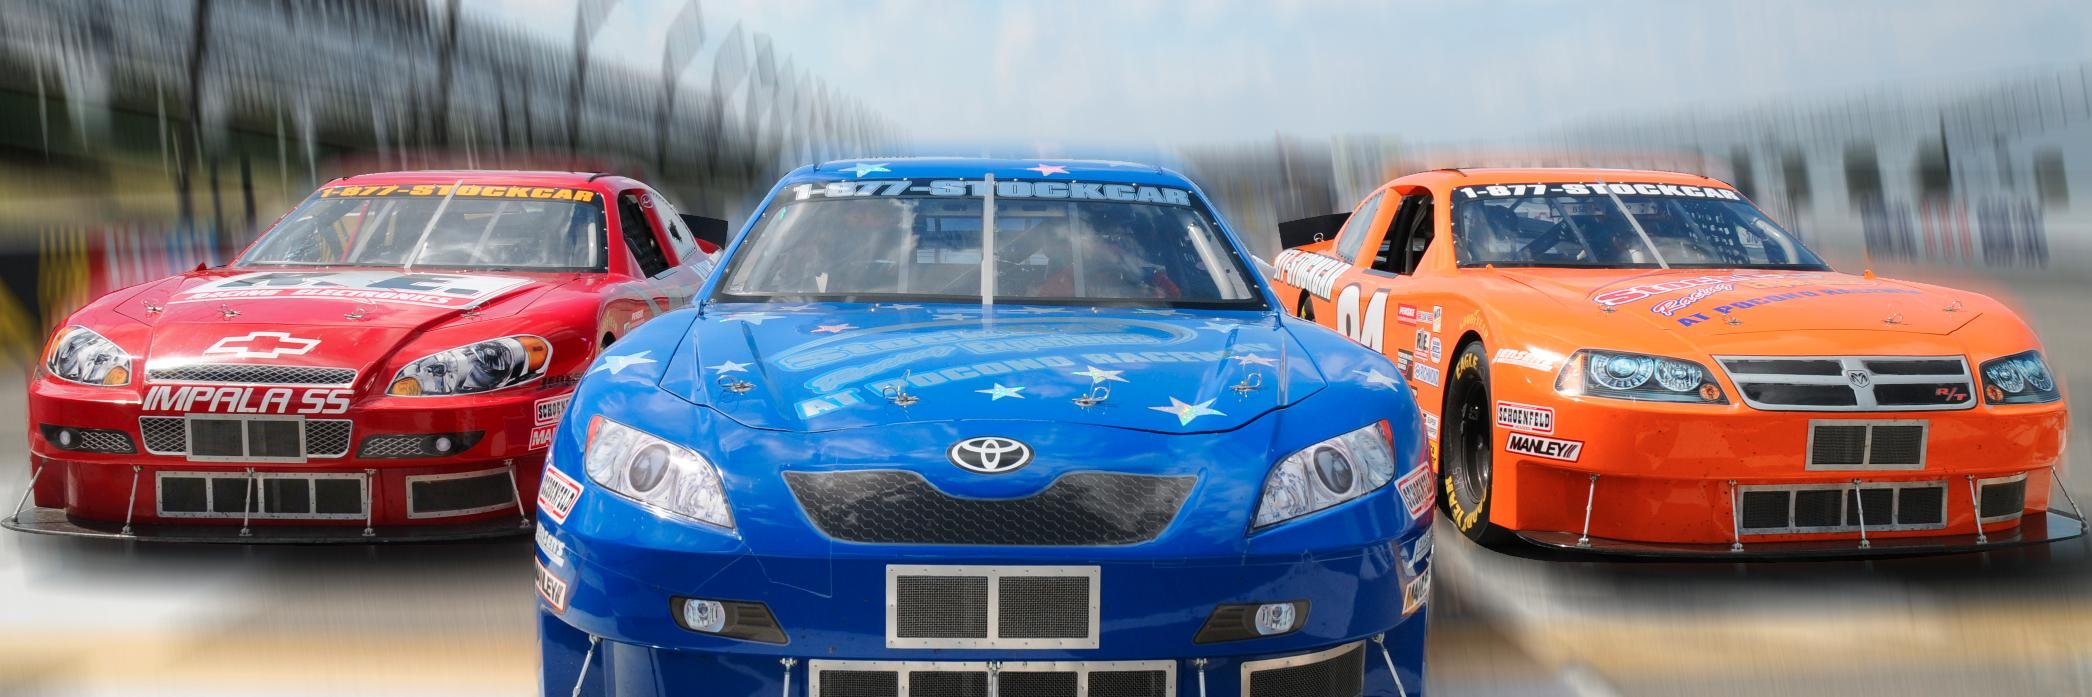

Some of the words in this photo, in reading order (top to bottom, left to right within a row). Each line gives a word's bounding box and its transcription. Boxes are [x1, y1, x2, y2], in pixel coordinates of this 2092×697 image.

[319, 184, 595, 202] 1-877-STOCKCAR
[794, 180, 1192, 206] 1-877-STOCKCAR
[1460, 183, 1741, 201] 1-877-STOCKCAR
[290, 288, 452, 304] ELECTRONICS
[1676, 312, 1711, 327] AT
[1713, 289, 1821, 315] POCONO
[1456, 352, 1479, 380] EAGLE
[797, 389, 864, 419] AT
[866, 355, 1076, 398] POCONO
[1935, 387, 1968, 401] R/T
[142, 386, 293, 413] IMPALA
[298, 389, 355, 414] SS
[1499, 407, 1550, 428] SCHOENFELD
[1509, 436, 1567, 456] MANLEY
